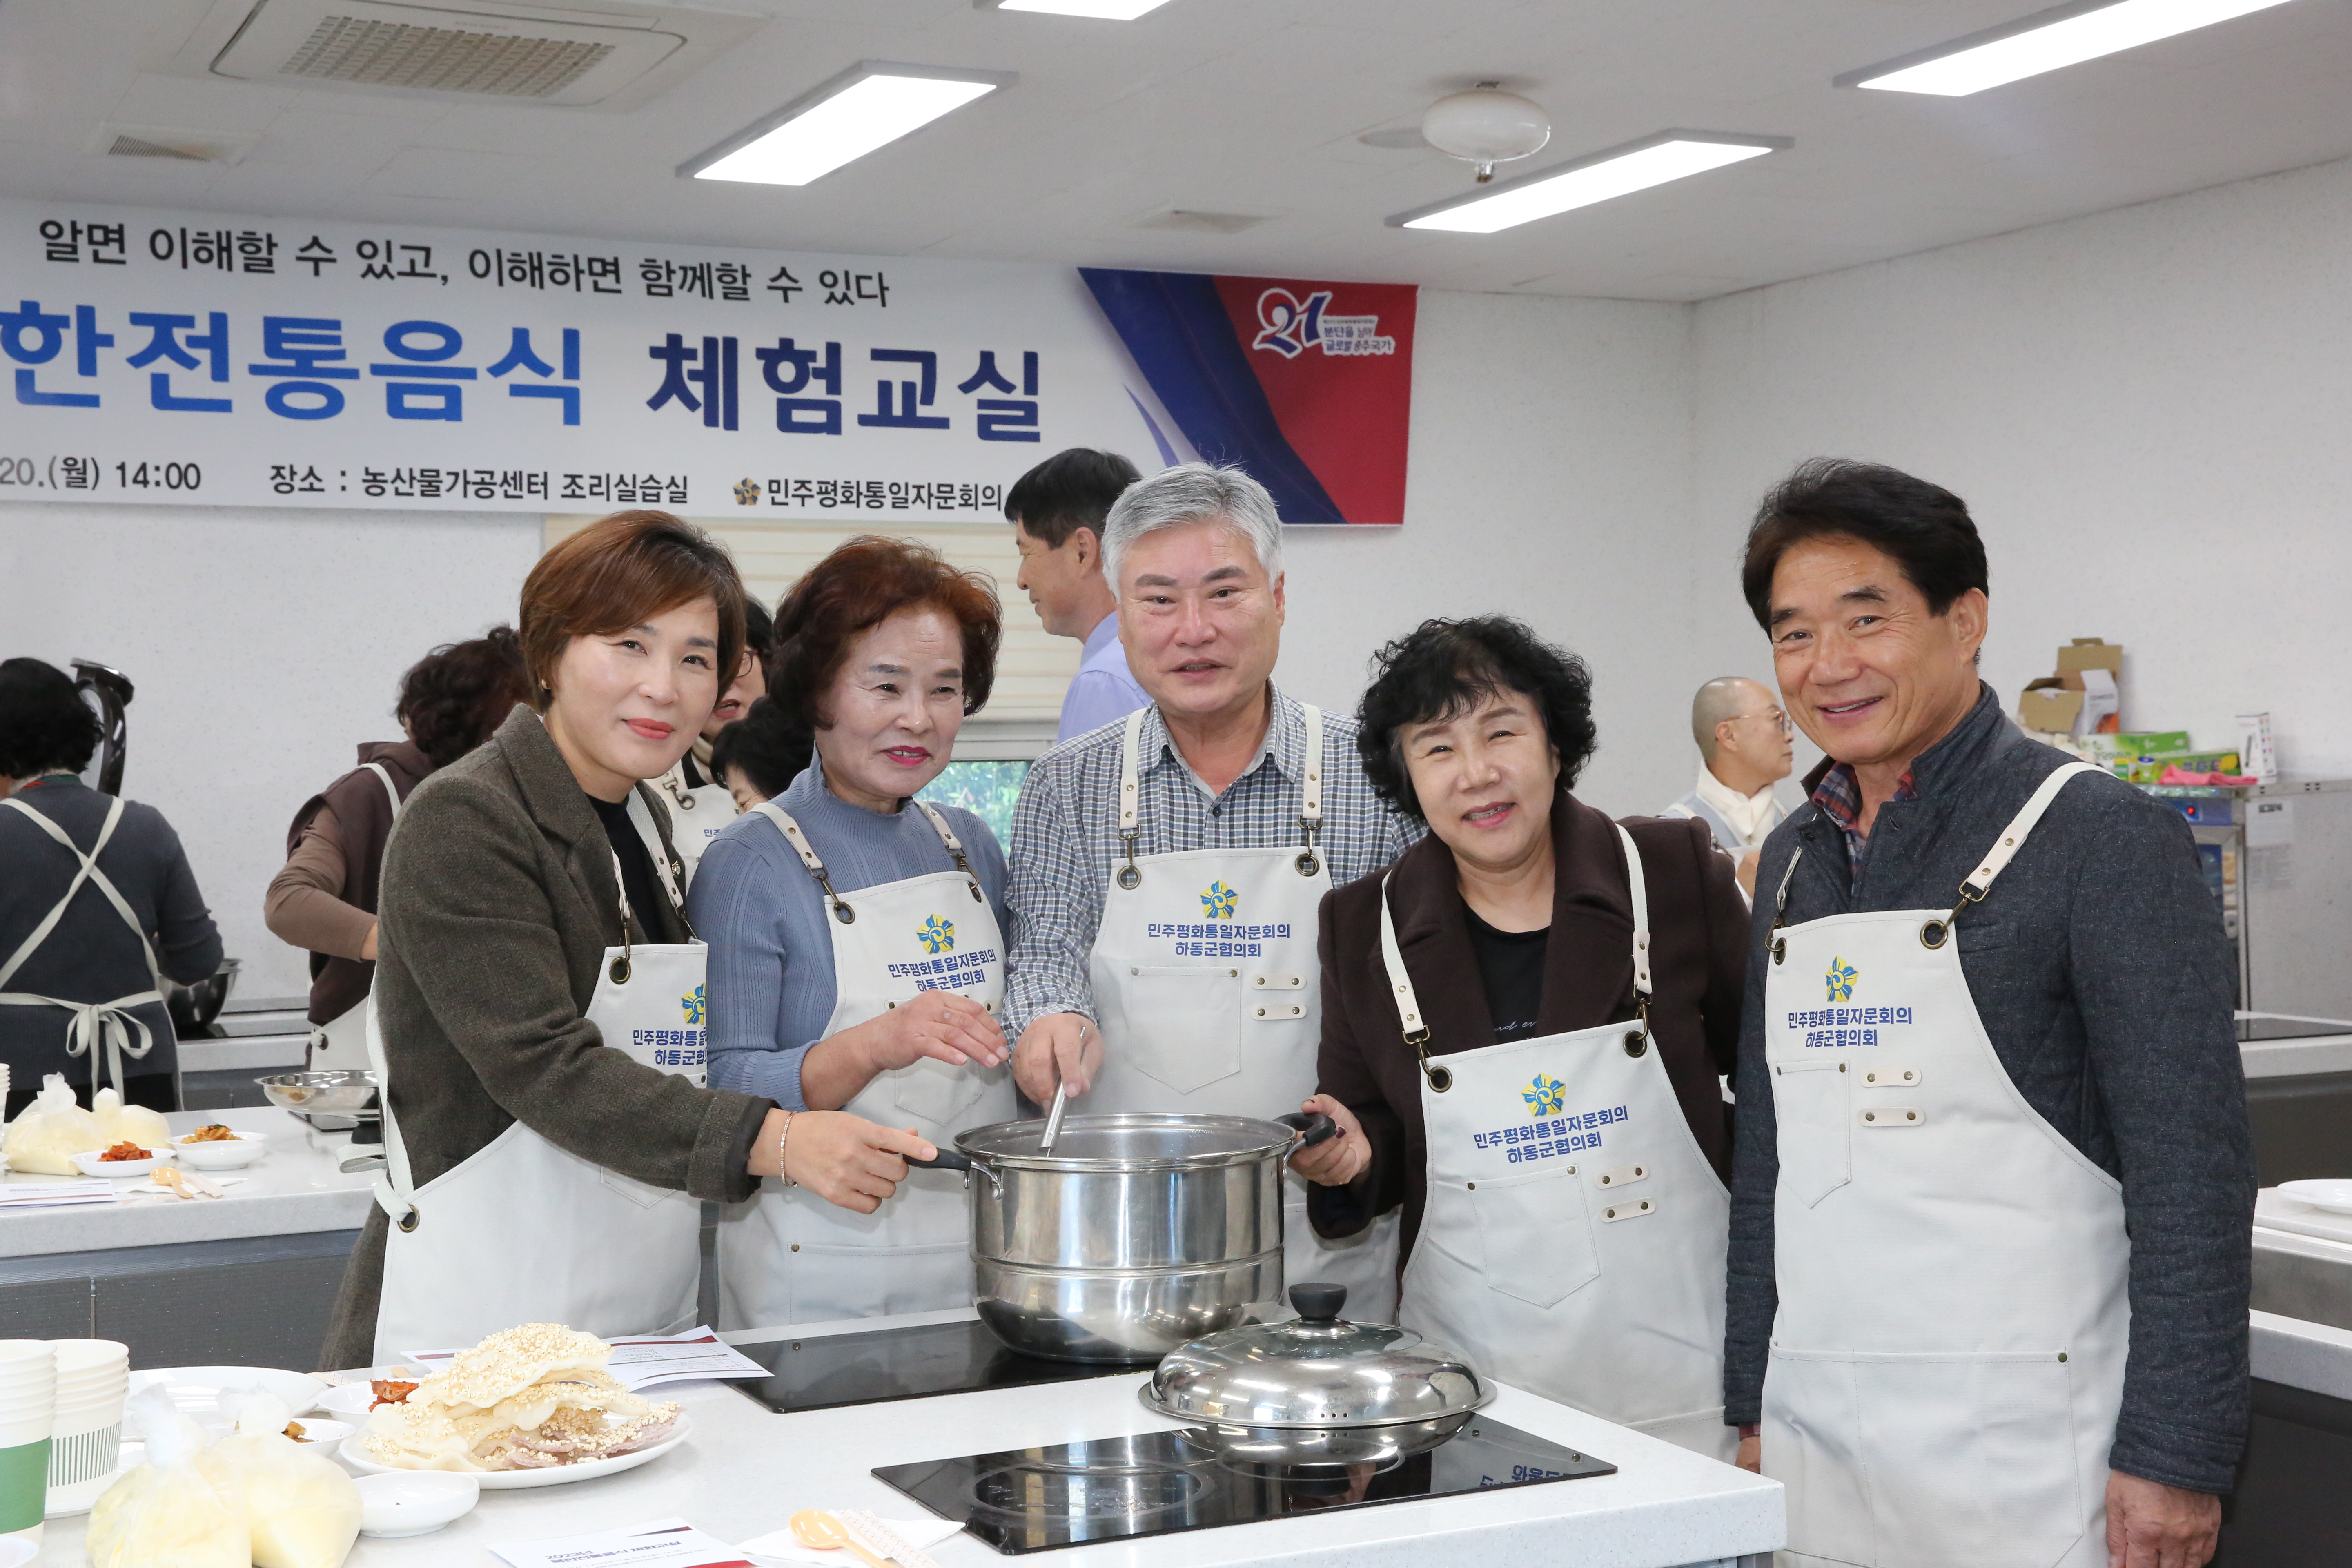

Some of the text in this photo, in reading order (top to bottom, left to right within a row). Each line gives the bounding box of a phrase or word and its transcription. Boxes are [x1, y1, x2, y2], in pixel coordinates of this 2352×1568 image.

[39, 219, 890, 307] 알면 이해할 수 있고, 이해하면 함께할 수 있다
[646, 332, 1041, 443] 체험교실
[116, 461, 201, 490] 14:00
[269, 464, 325, 494] 장소
[361, 466, 548, 500] 농산물가공센터
[561, 473, 688, 503] 조리실습실
[768, 478, 1002, 512] 민주평화통일자문회의
[1147, 923, 1290, 940] 민주평화통일자문회의
[887, 948, 997, 978] 민주평화통일자문회의
[1175, 941, 1261, 958] 하동군협의회
[915, 969, 986, 993] 하동군협의회
[1788, 1007, 1913, 1029] 민주평화통일자문회의
[1805, 1029, 1878, 1048] 하동군협의회
[1473, 1105, 1628, 1149] 민주평화통일자문회의
[1506, 1131, 1603, 1163] 하동군협의회
